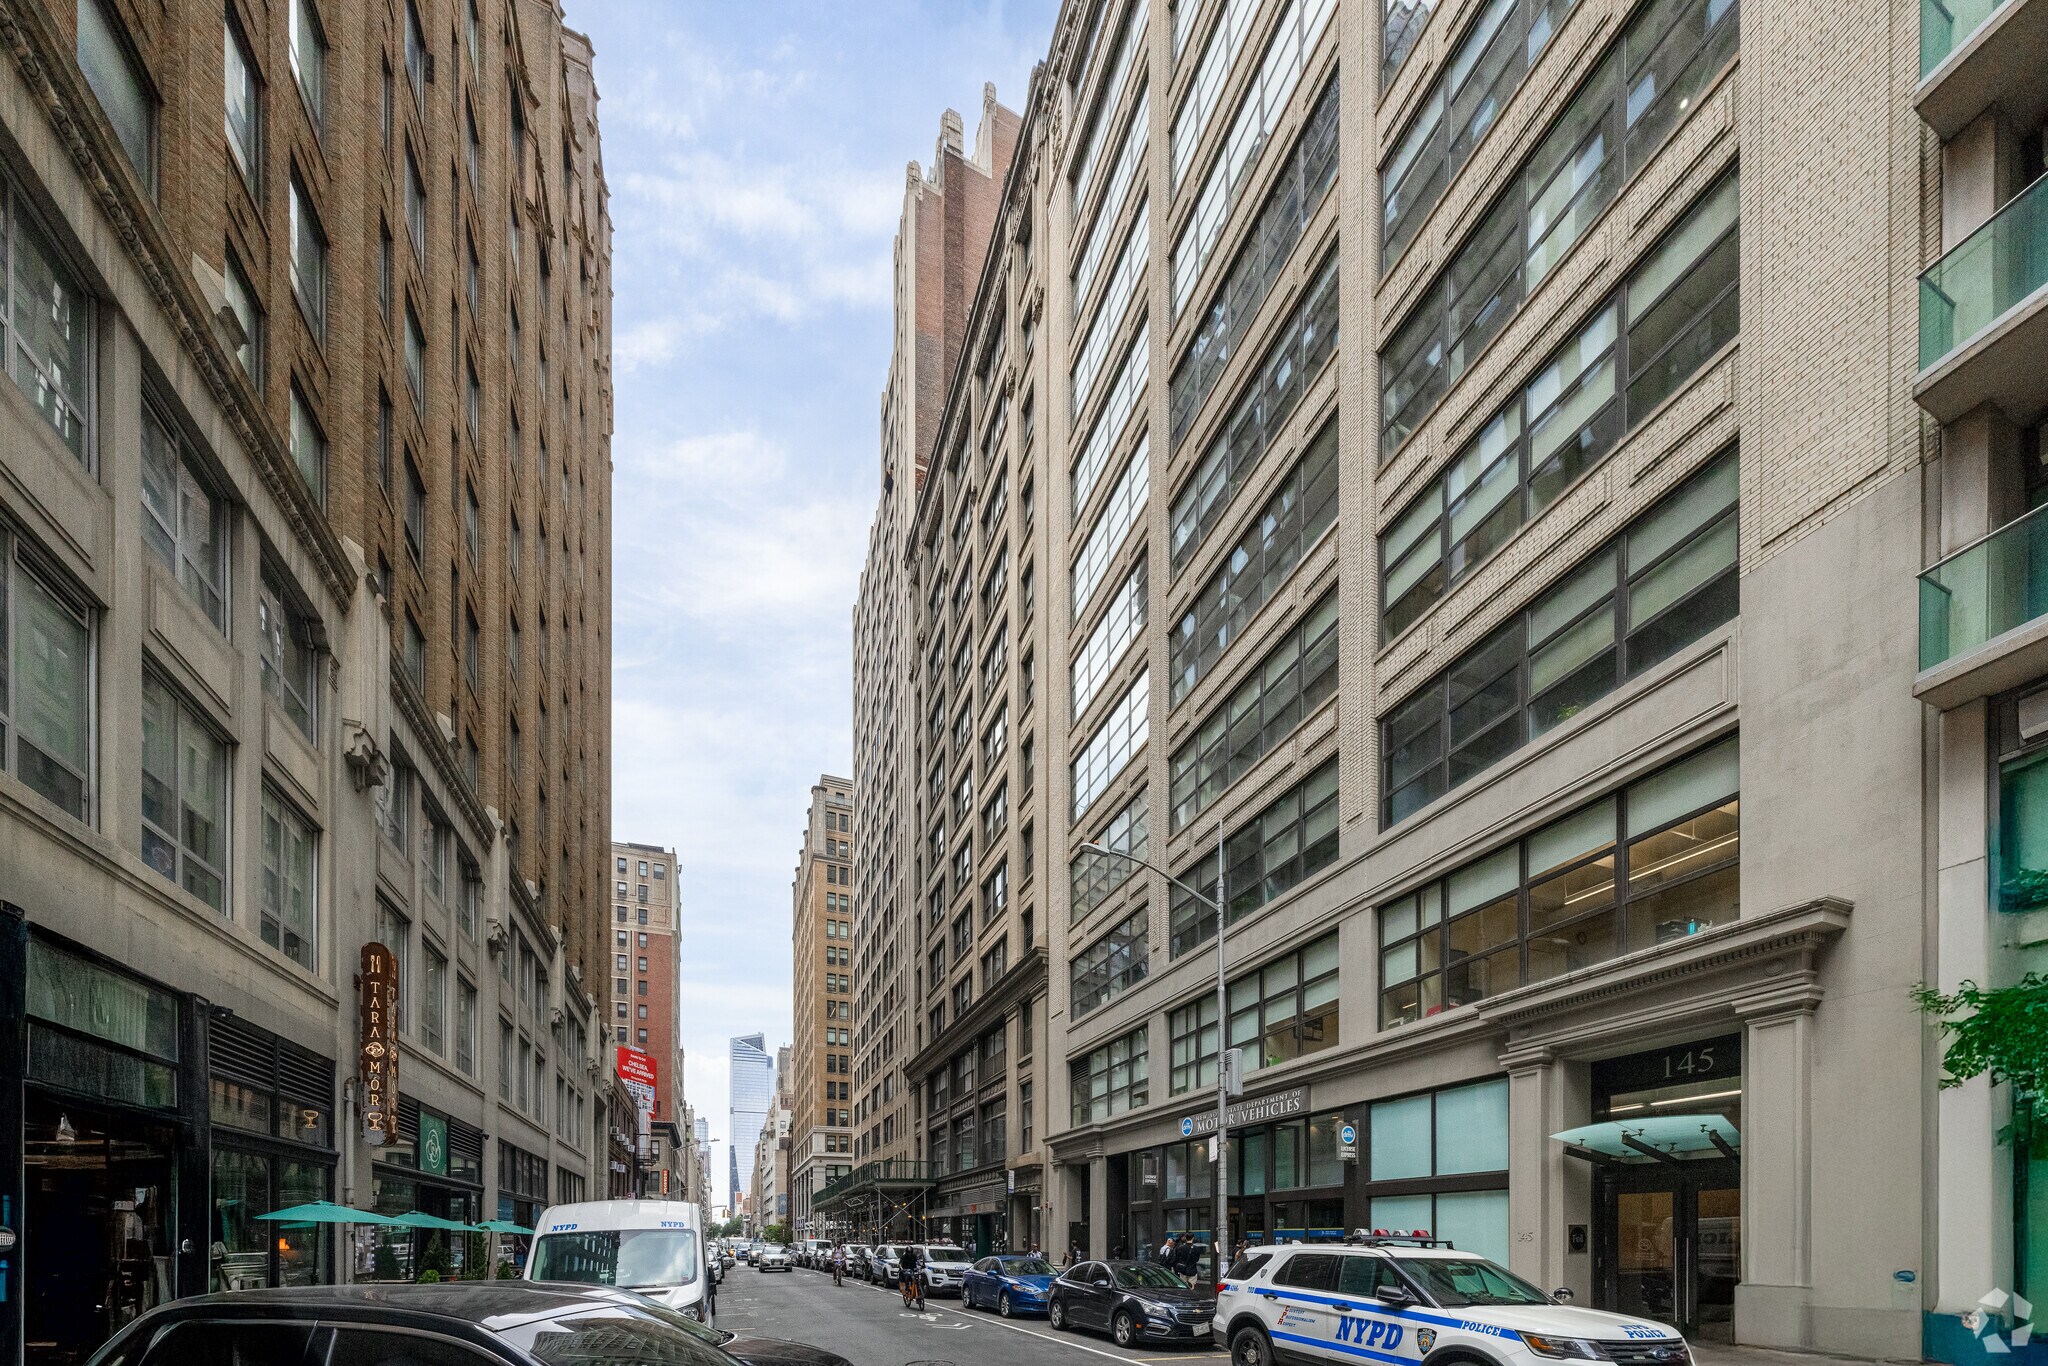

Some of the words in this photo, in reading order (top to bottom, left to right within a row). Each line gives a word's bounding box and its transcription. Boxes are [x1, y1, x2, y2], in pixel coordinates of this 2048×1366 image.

[370, 981, 381, 1038] TARA
[1663, 1047, 1714, 1078] 145
[1197, 1113, 1235, 1132] MOTR
[1241, 1097, 1300, 1122] VEHICLES
[1226, 1105, 1243, 1114] STATE
[1246, 1093, 1288, 1109] DEPARTMENT
[1292, 1089, 1302, 1098] OF
[552, 1223, 578, 1231] NYPD
[1335, 1315, 1404, 1350] NYPD
[1461, 1320, 1500, 1336] POLICE
[1624, 1330, 1667, 1338] POLICE
